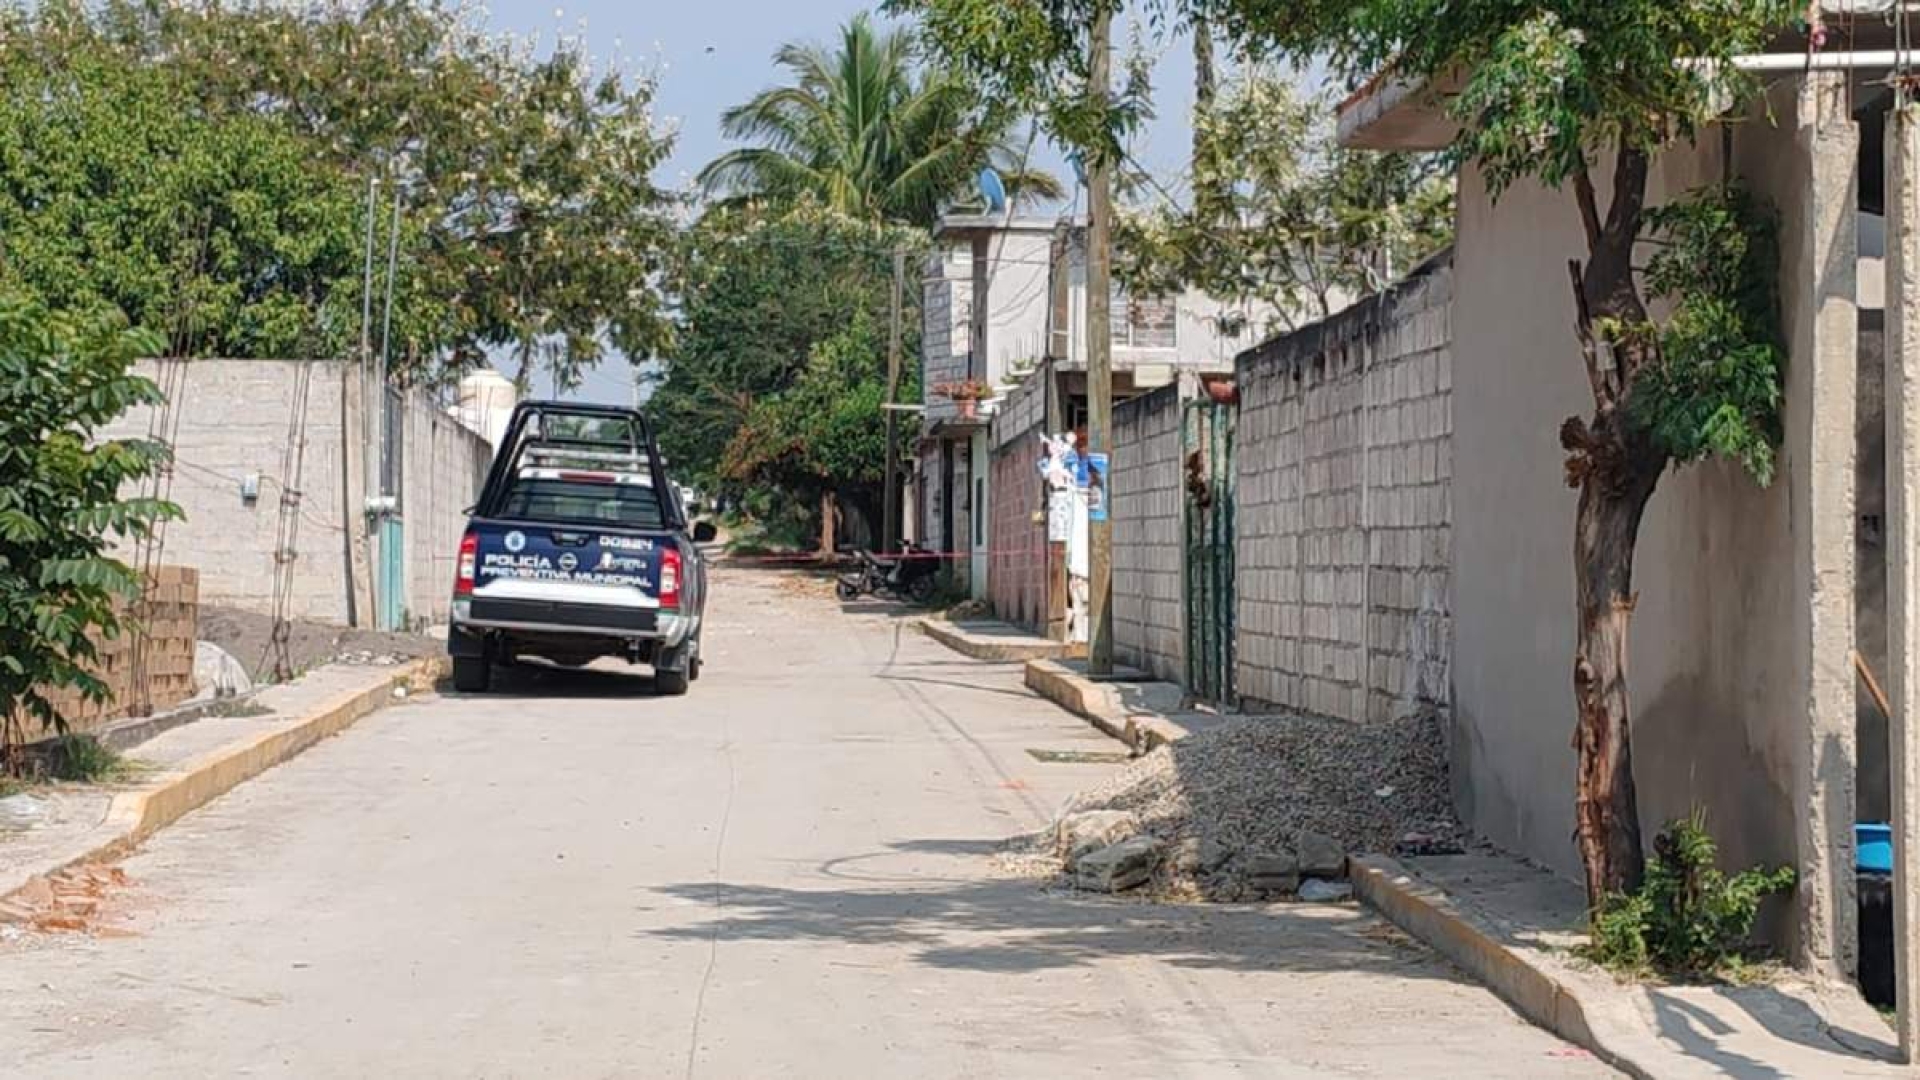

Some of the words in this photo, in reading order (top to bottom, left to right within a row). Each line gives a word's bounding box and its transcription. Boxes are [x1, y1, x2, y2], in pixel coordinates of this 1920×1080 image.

[485, 553, 552, 569] POLICÍA
[481, 566, 571, 581] PREVENTIVA
[575, 571, 653, 587] MUNICIPAL
